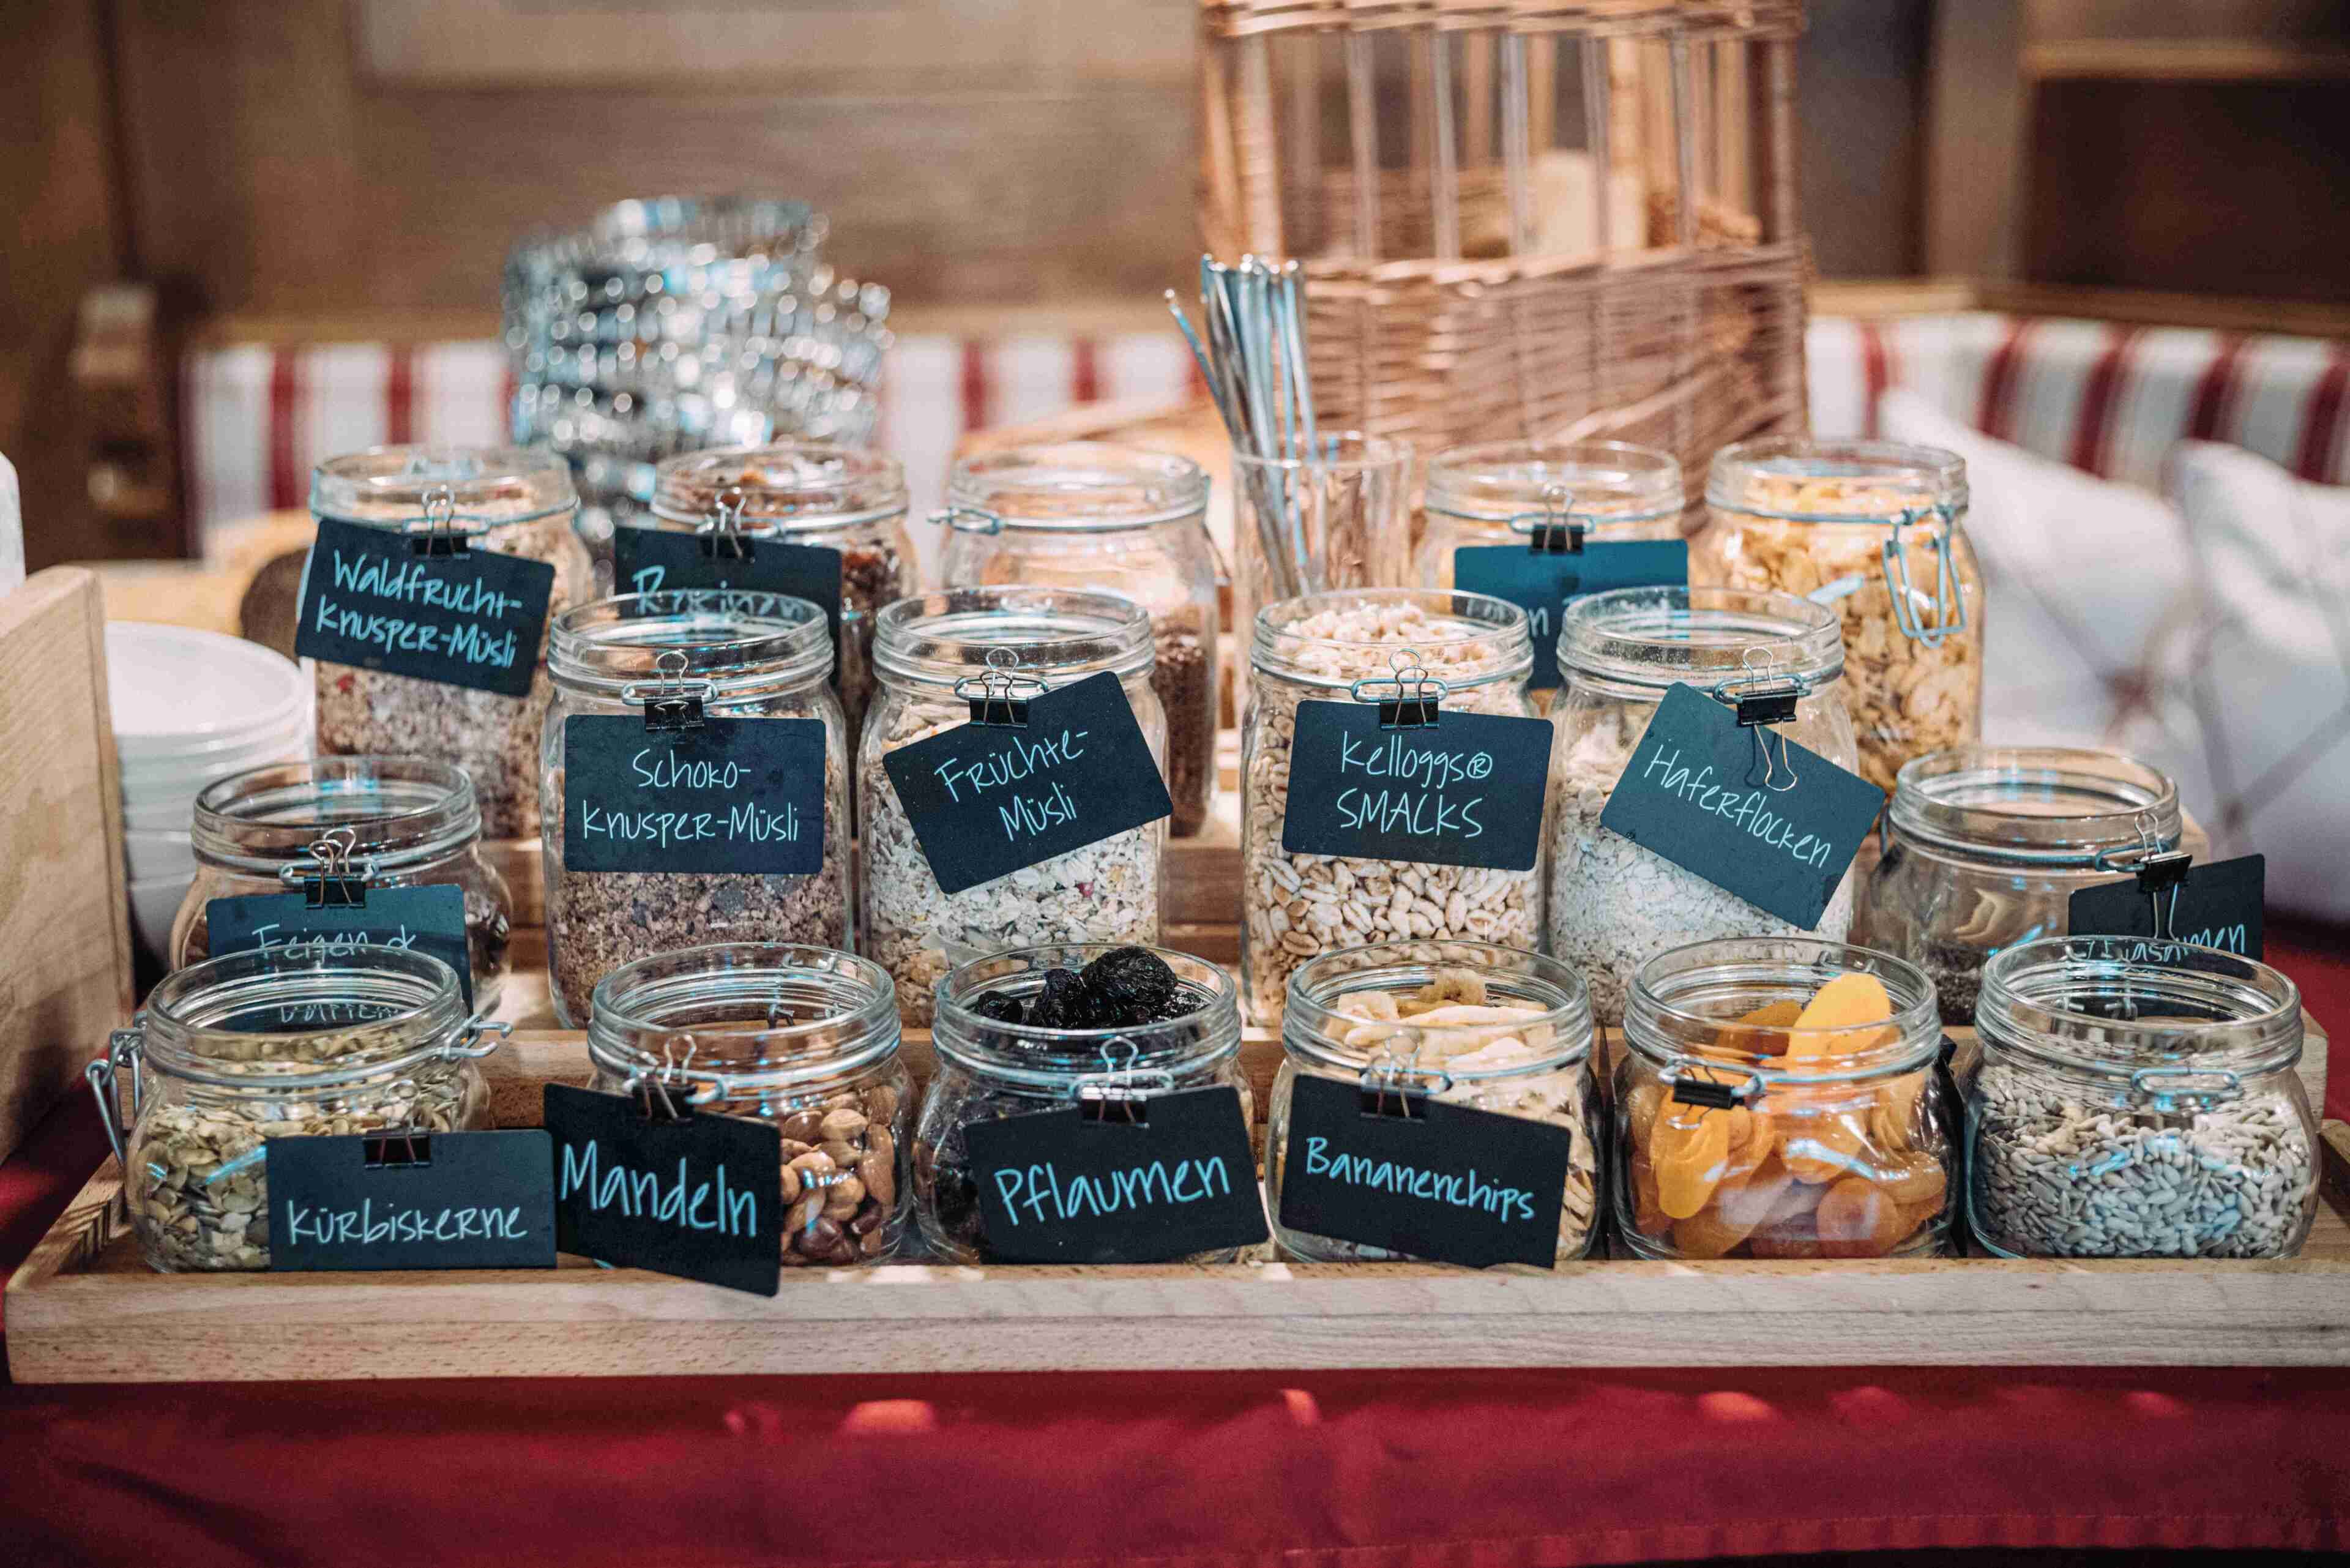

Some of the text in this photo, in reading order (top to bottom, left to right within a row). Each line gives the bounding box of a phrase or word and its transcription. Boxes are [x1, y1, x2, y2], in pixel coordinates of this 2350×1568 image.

[334, 549, 522, 619] Waldfrucht-
[315, 594, 517, 668] Knusper-Müsli
[632, 748, 752, 790] Schoko-
[934, 729, 1089, 803] Früchte-
[583, 798, 799, 849] Knusper-Müsli
[998, 780, 1078, 842] Müsli
[1336, 788, 1483, 838] SMACKS
[1643, 744, 1832, 869] Haferflocken
[561, 1140, 757, 1238] Mandeln
[993, 1155, 1231, 1226] Pflaumen
[1306, 1137, 1535, 1222] Bananenchips
[288, 1197, 528, 1245] Kürbiskerne
